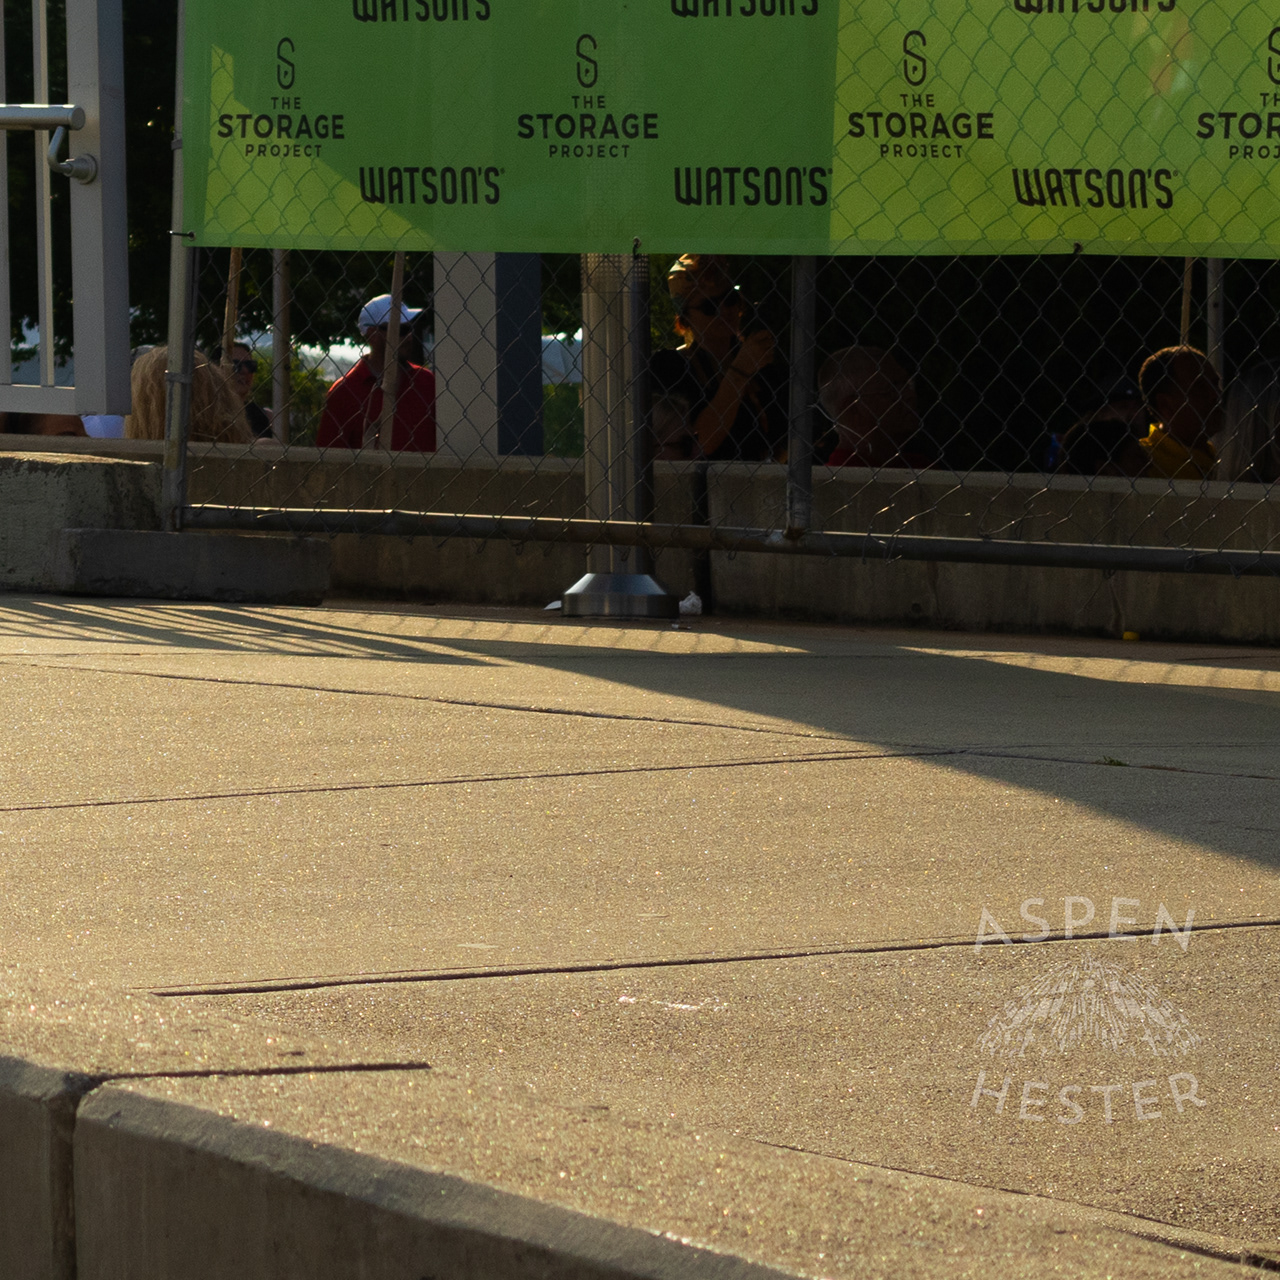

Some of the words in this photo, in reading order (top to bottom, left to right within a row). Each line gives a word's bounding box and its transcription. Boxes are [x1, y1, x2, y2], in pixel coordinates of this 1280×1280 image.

[270, 96, 302, 110] THE
[571, 94, 606, 109] THE
[899, 93, 935, 108] THE
[217, 113, 346, 140] STORAGE
[517, 113, 659, 140] STORAGE
[847, 111, 994, 139] STORAGE
[245, 143, 323, 158] PROJECT
[548, 144, 630, 159] PROJECT
[879, 143, 963, 159] PROJECT
[359, 166, 500, 205] WATSON'S
[674, 166, 828, 207] WATSON'S
[1012, 168, 1174, 210] WATSON'S
